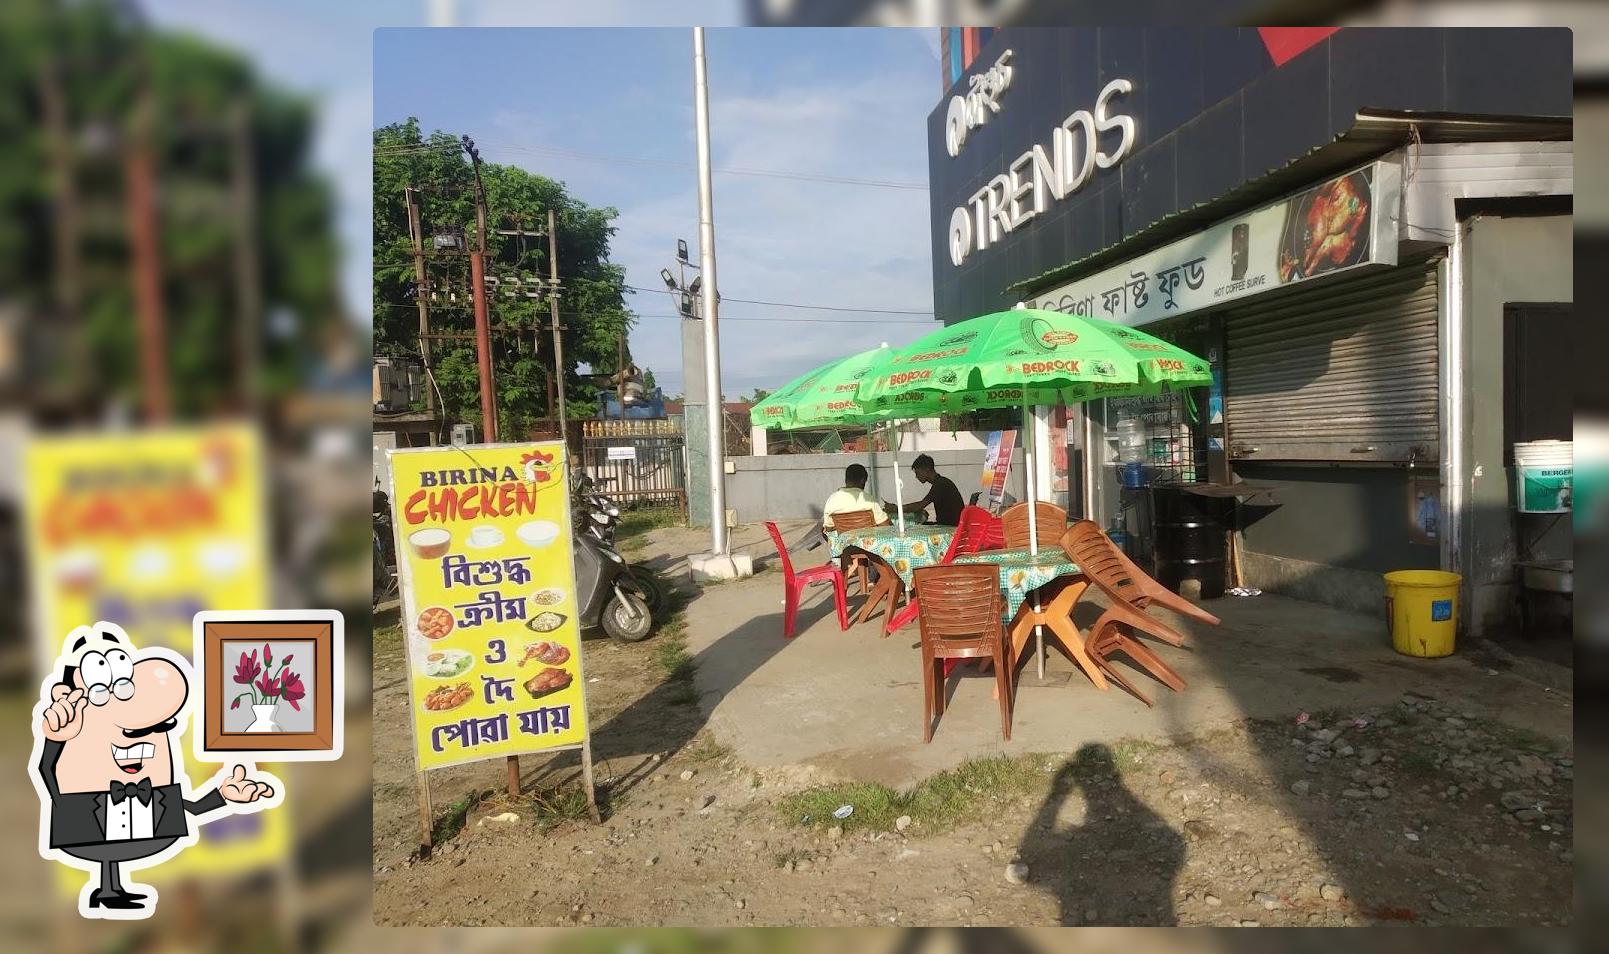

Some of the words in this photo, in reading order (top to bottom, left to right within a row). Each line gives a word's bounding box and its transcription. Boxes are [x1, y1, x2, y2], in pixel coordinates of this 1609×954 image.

[968, 79, 1135, 250] TRENDS
[1155, 256, 1207, 310] ফুড
[1213, 286, 1225, 298] HOT
[1225, 280, 1246, 294] COFFEE
[1246, 274, 1266, 289] SURVE
[890, 370, 933, 386] BEDROCK
[1022, 360, 1080, 374] BEDROCK
[420, 465, 519, 488] BIRINA
[404, 481, 537, 525] CHICKEN
[441, 554, 531, 588] বিশুদ্ধ
[484, 639, 507, 664] ও
[481, 675, 515, 704] দৈ
